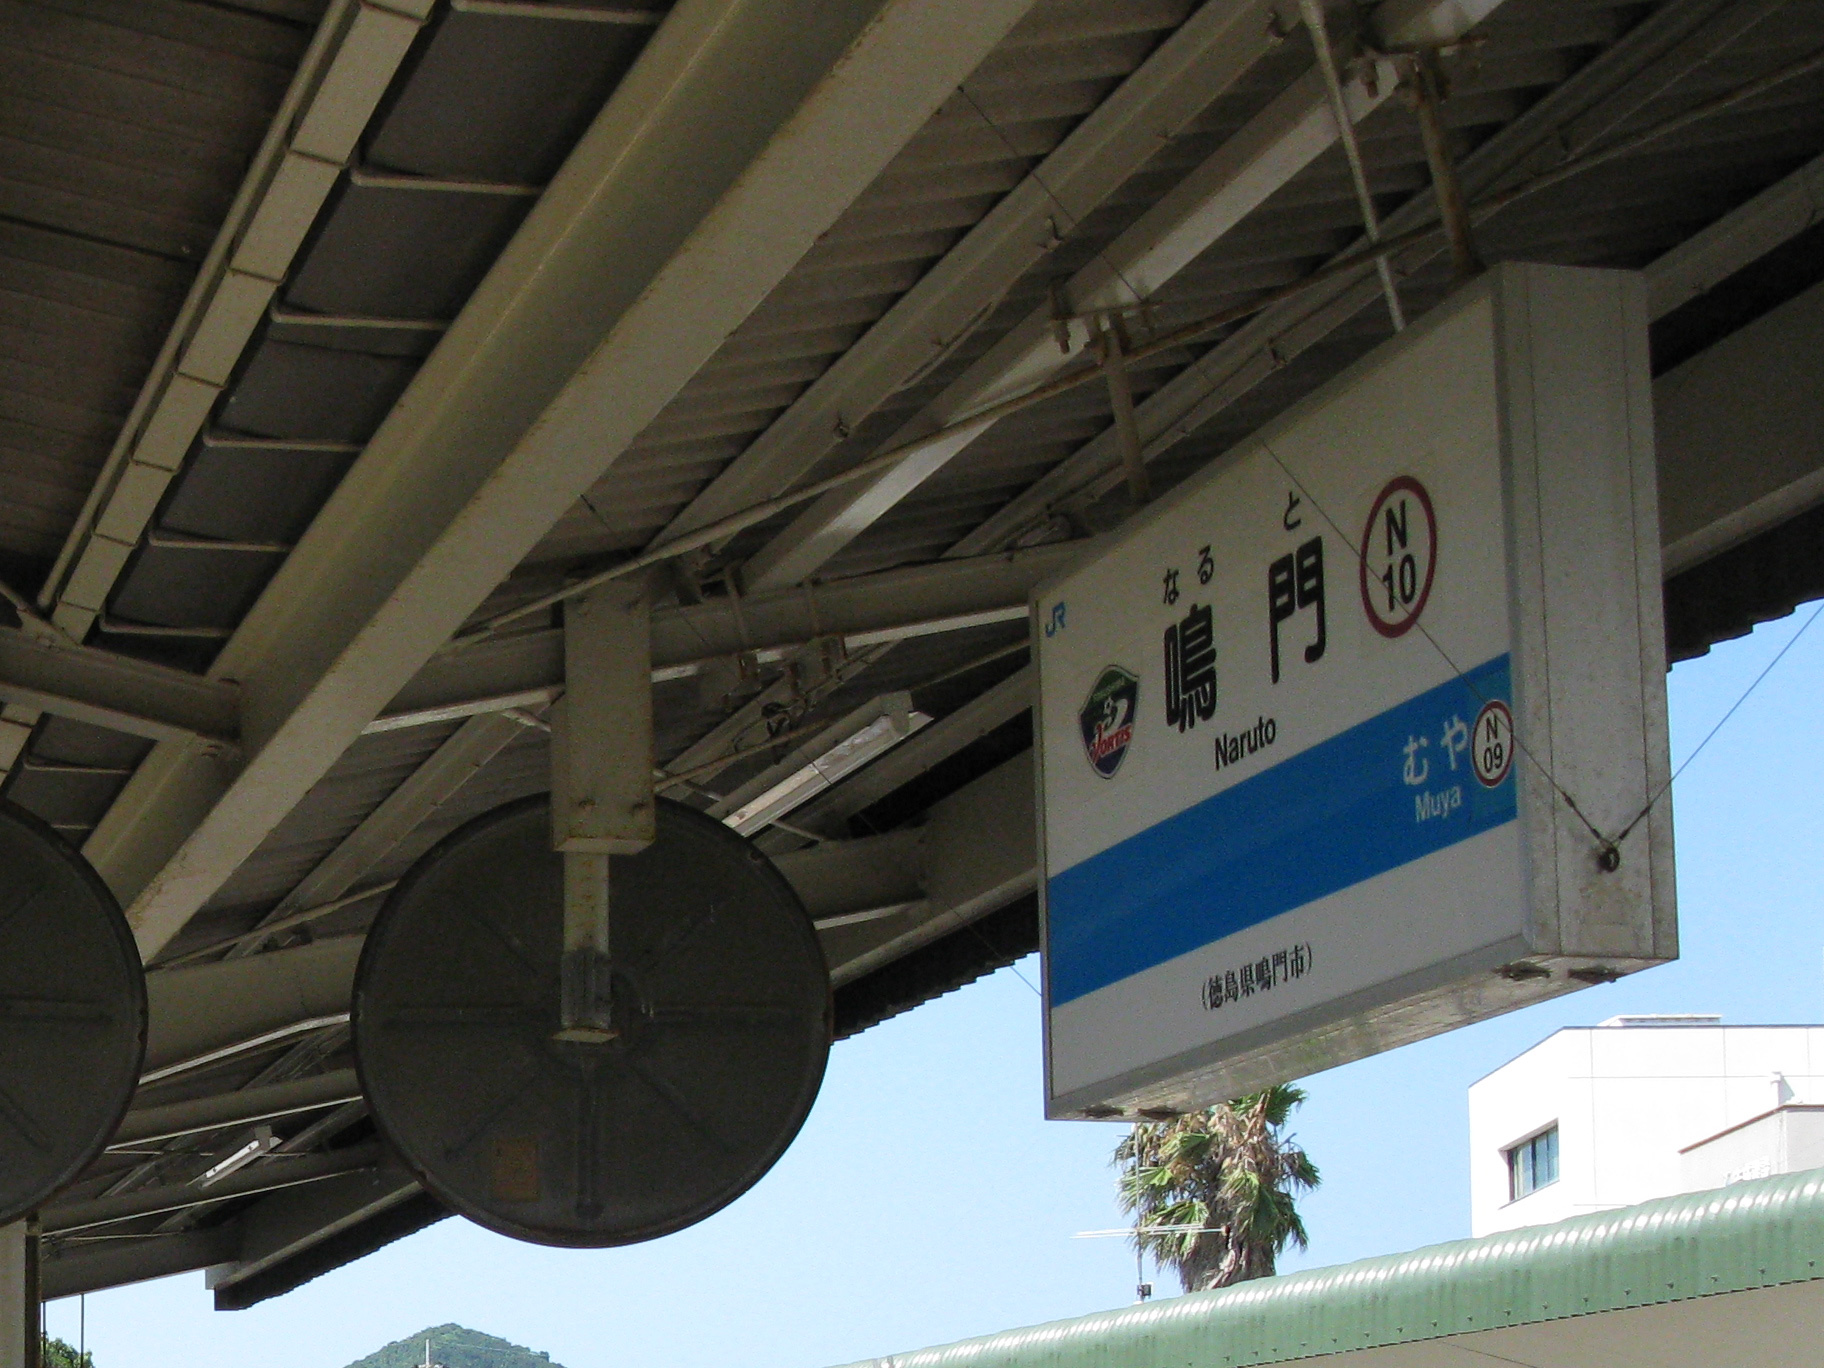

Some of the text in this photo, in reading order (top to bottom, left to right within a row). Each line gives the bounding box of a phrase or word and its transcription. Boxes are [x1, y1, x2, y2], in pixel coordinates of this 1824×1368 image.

[1385, 501, 1408, 553] N
[1382, 556, 1416, 612] 10
[1045, 601, 1066, 637] JR
[1214, 715, 1277, 771] Naruto
[1401, 712, 1469, 786] むや
[1485, 722, 1498, 743] N
[1482, 740, 1504, 772] 09
[1415, 784, 1462, 823] Muya
